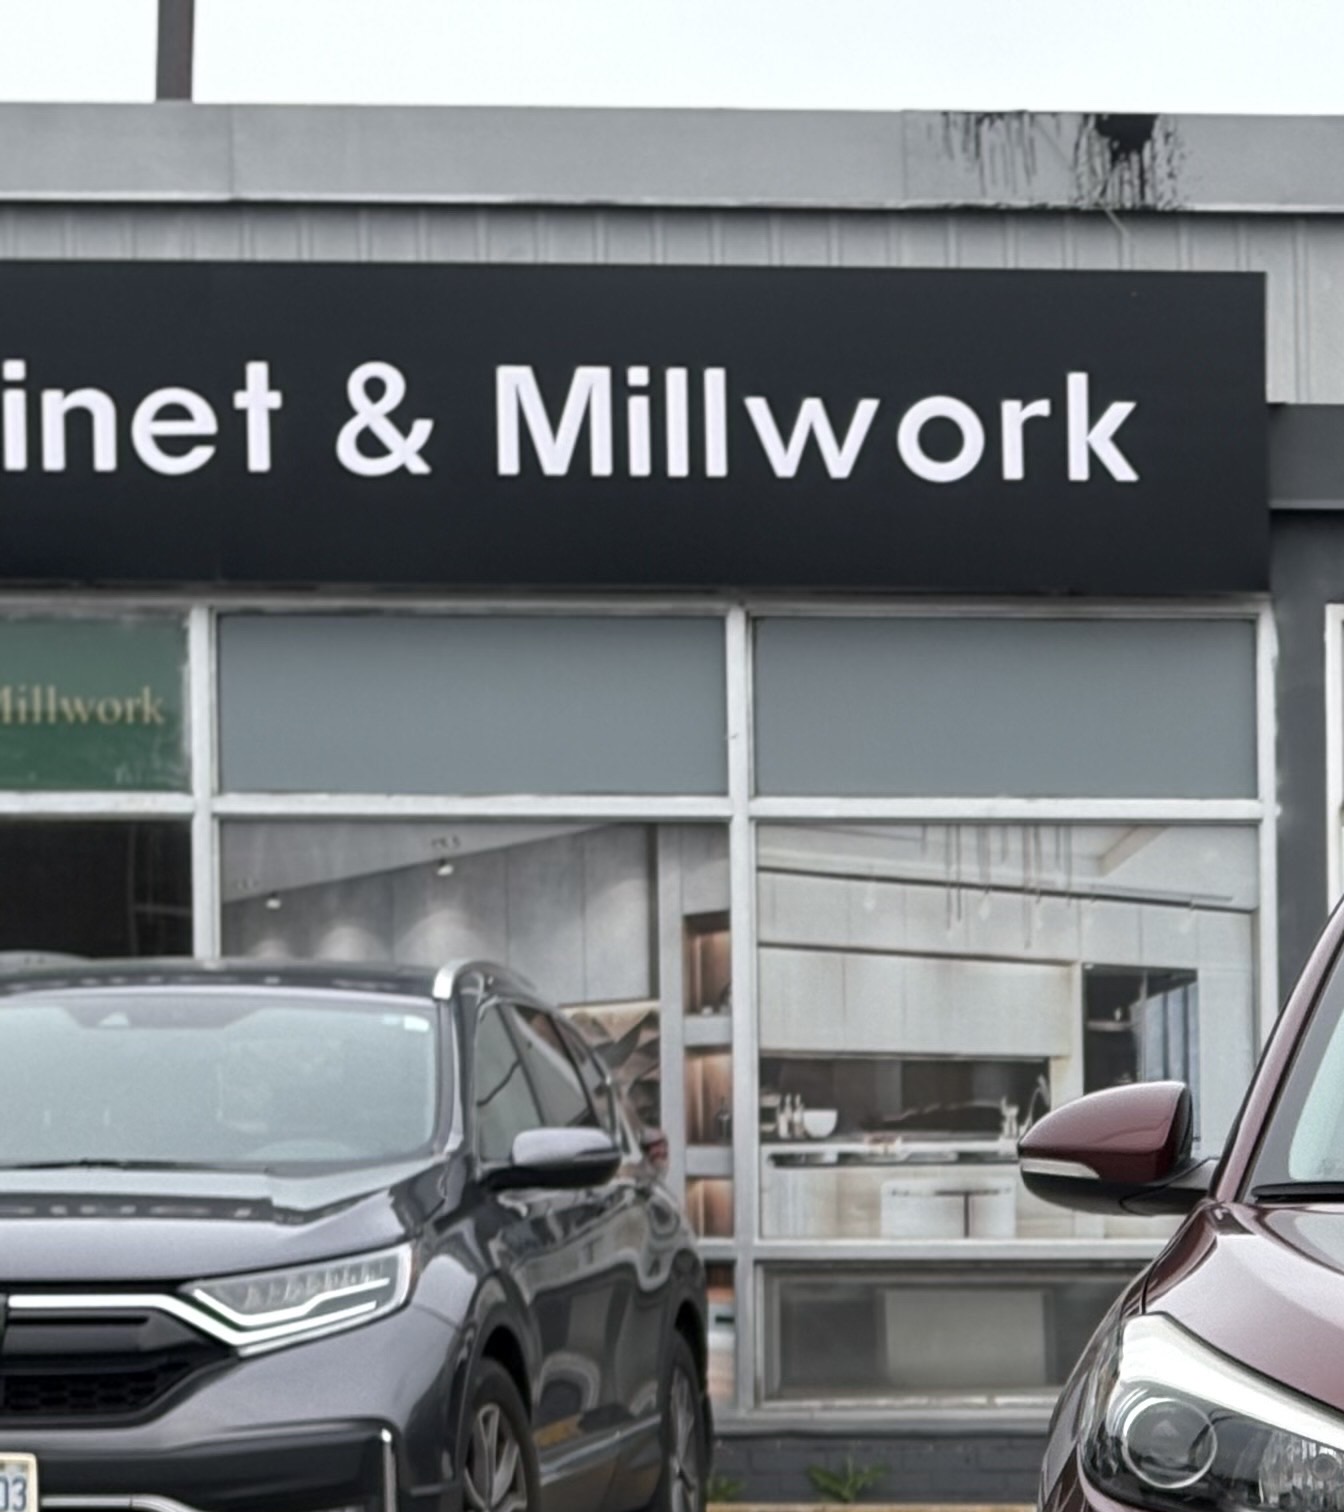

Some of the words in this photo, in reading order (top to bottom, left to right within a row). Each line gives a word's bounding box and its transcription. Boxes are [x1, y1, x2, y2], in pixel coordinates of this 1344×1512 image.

[2, 359, 283, 475] inet
[336, 361, 434, 477] &
[495, 364, 1139, 483] Millwork
